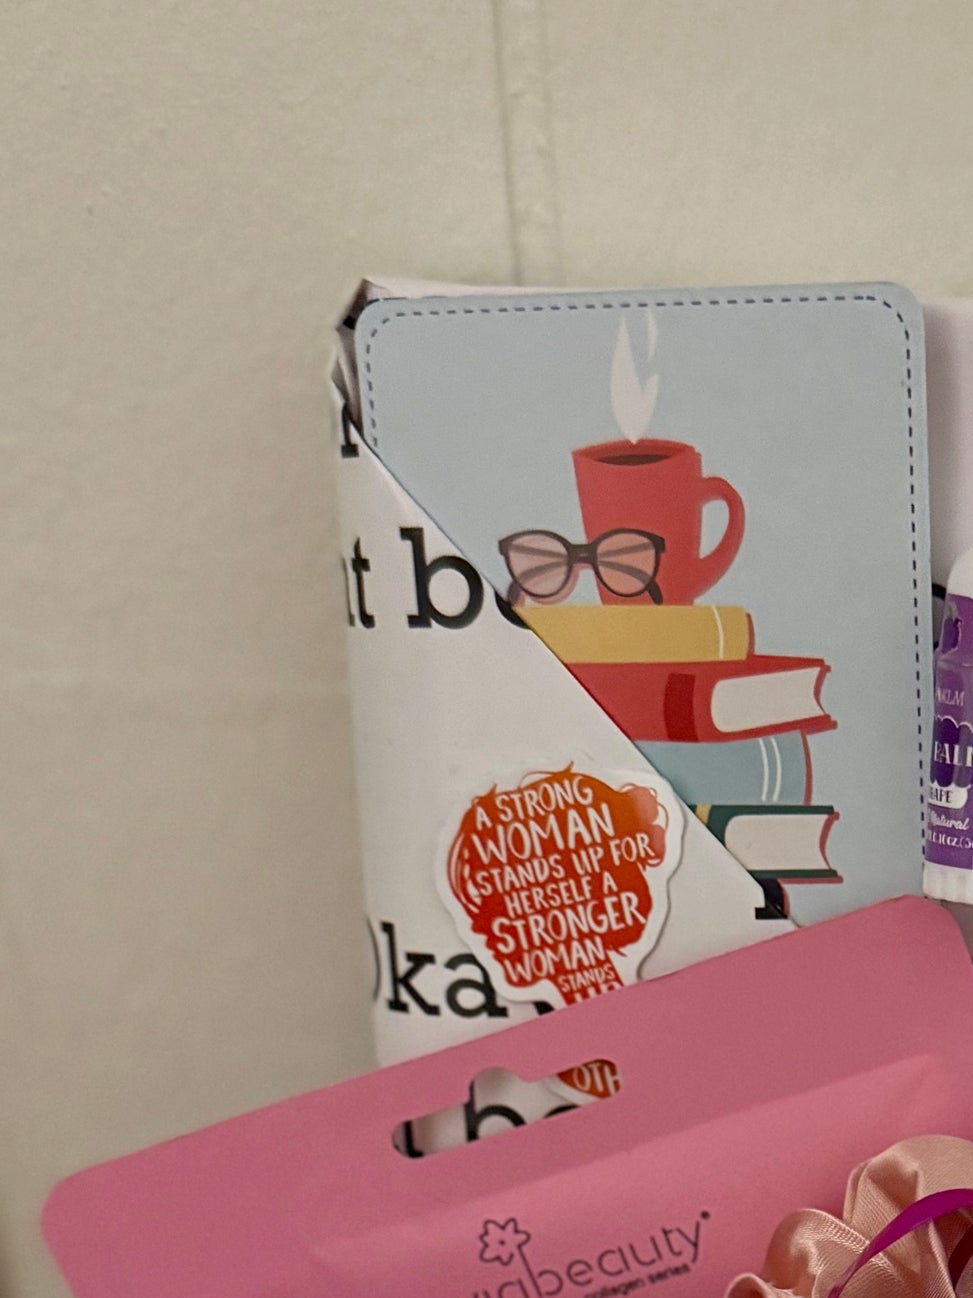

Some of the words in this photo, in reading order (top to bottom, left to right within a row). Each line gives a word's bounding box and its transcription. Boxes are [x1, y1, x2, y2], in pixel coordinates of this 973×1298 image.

[476, 805, 493, 831] A
[494, 774, 594, 822] STRONG
[472, 802, 616, 865] WOMAN
[475, 853, 566, 896] STANDS
[571, 847, 604, 876] UP
[609, 832, 656, 866] FOR
[504, 875, 593, 919] HERSELF
[603, 871, 618, 894] A
[491, 890, 648, 954] STRONGER
[504, 935, 606, 984] WOMAN
[557, 963, 616, 993] STANDS
[649, 1263, 692, 1286] series
